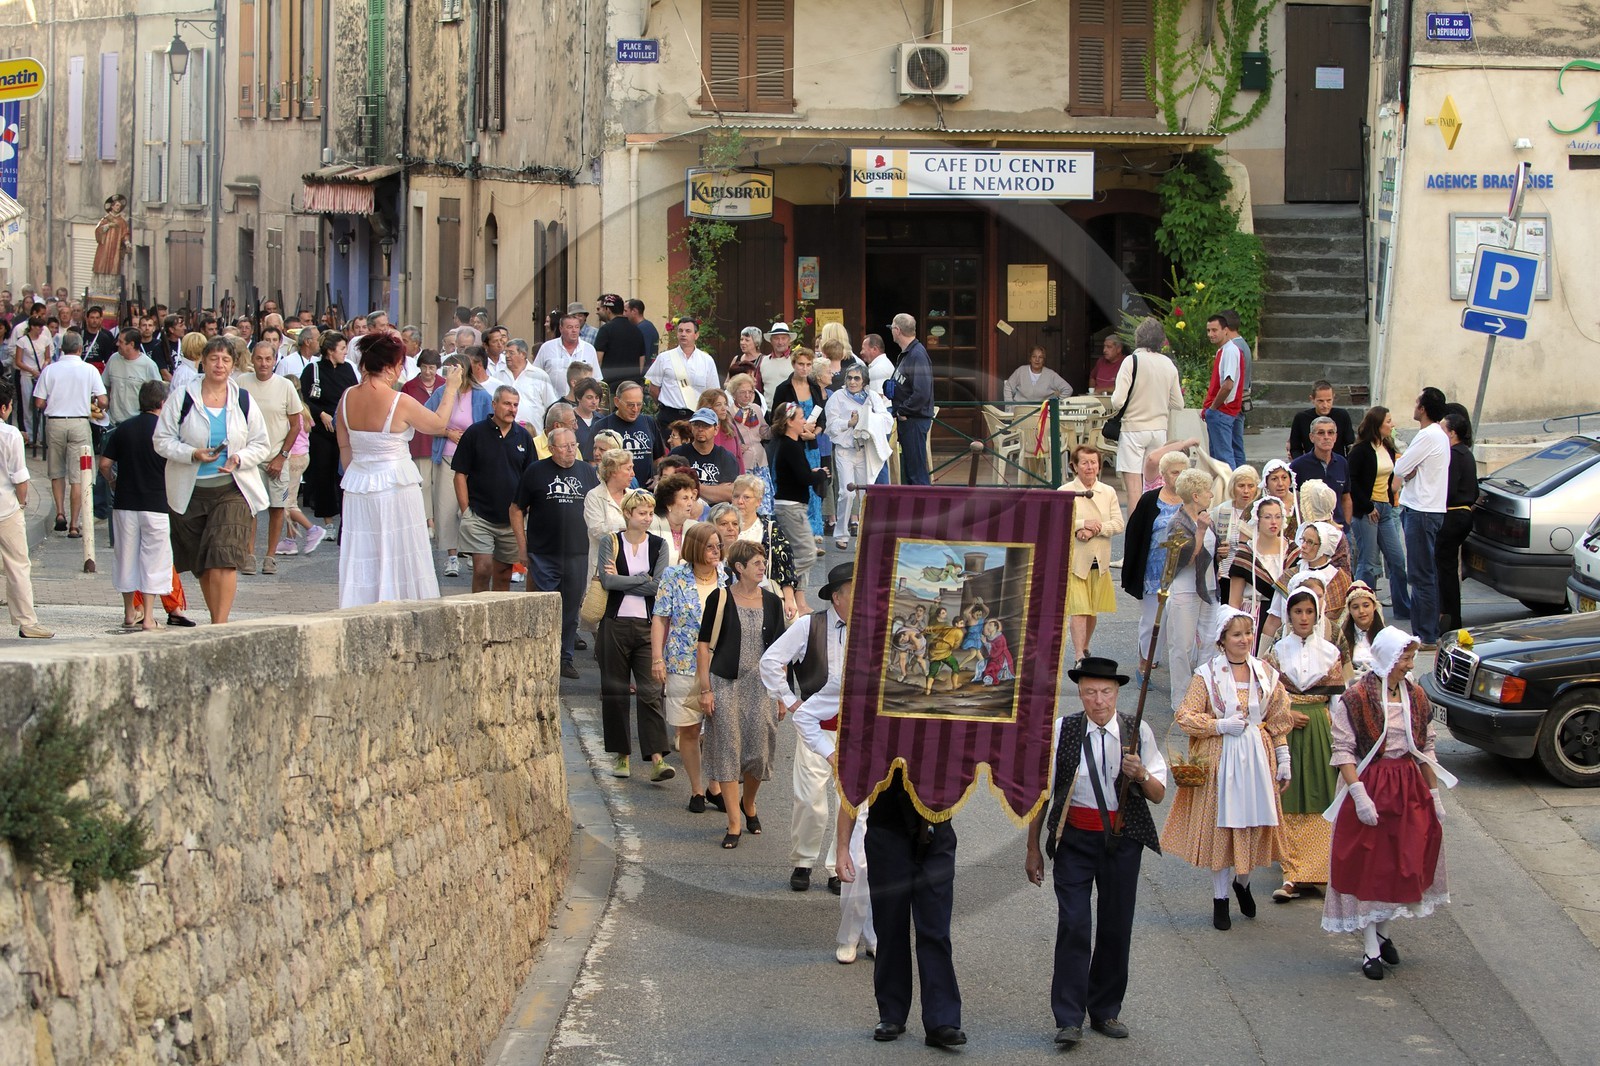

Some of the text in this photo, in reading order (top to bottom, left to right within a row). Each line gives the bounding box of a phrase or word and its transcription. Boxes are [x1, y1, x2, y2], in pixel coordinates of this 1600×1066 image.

[1435, 18, 1450, 26] RUE
[619, 51, 657, 59] 14 JUILLET
[924, 157, 1077, 174] CAFE DU CENTRE
[948, 176, 1055, 192] LE NEMROD
[1426, 174, 1554, 189] AGENCE BRASISE
[1489, 262, 1520, 300] P
